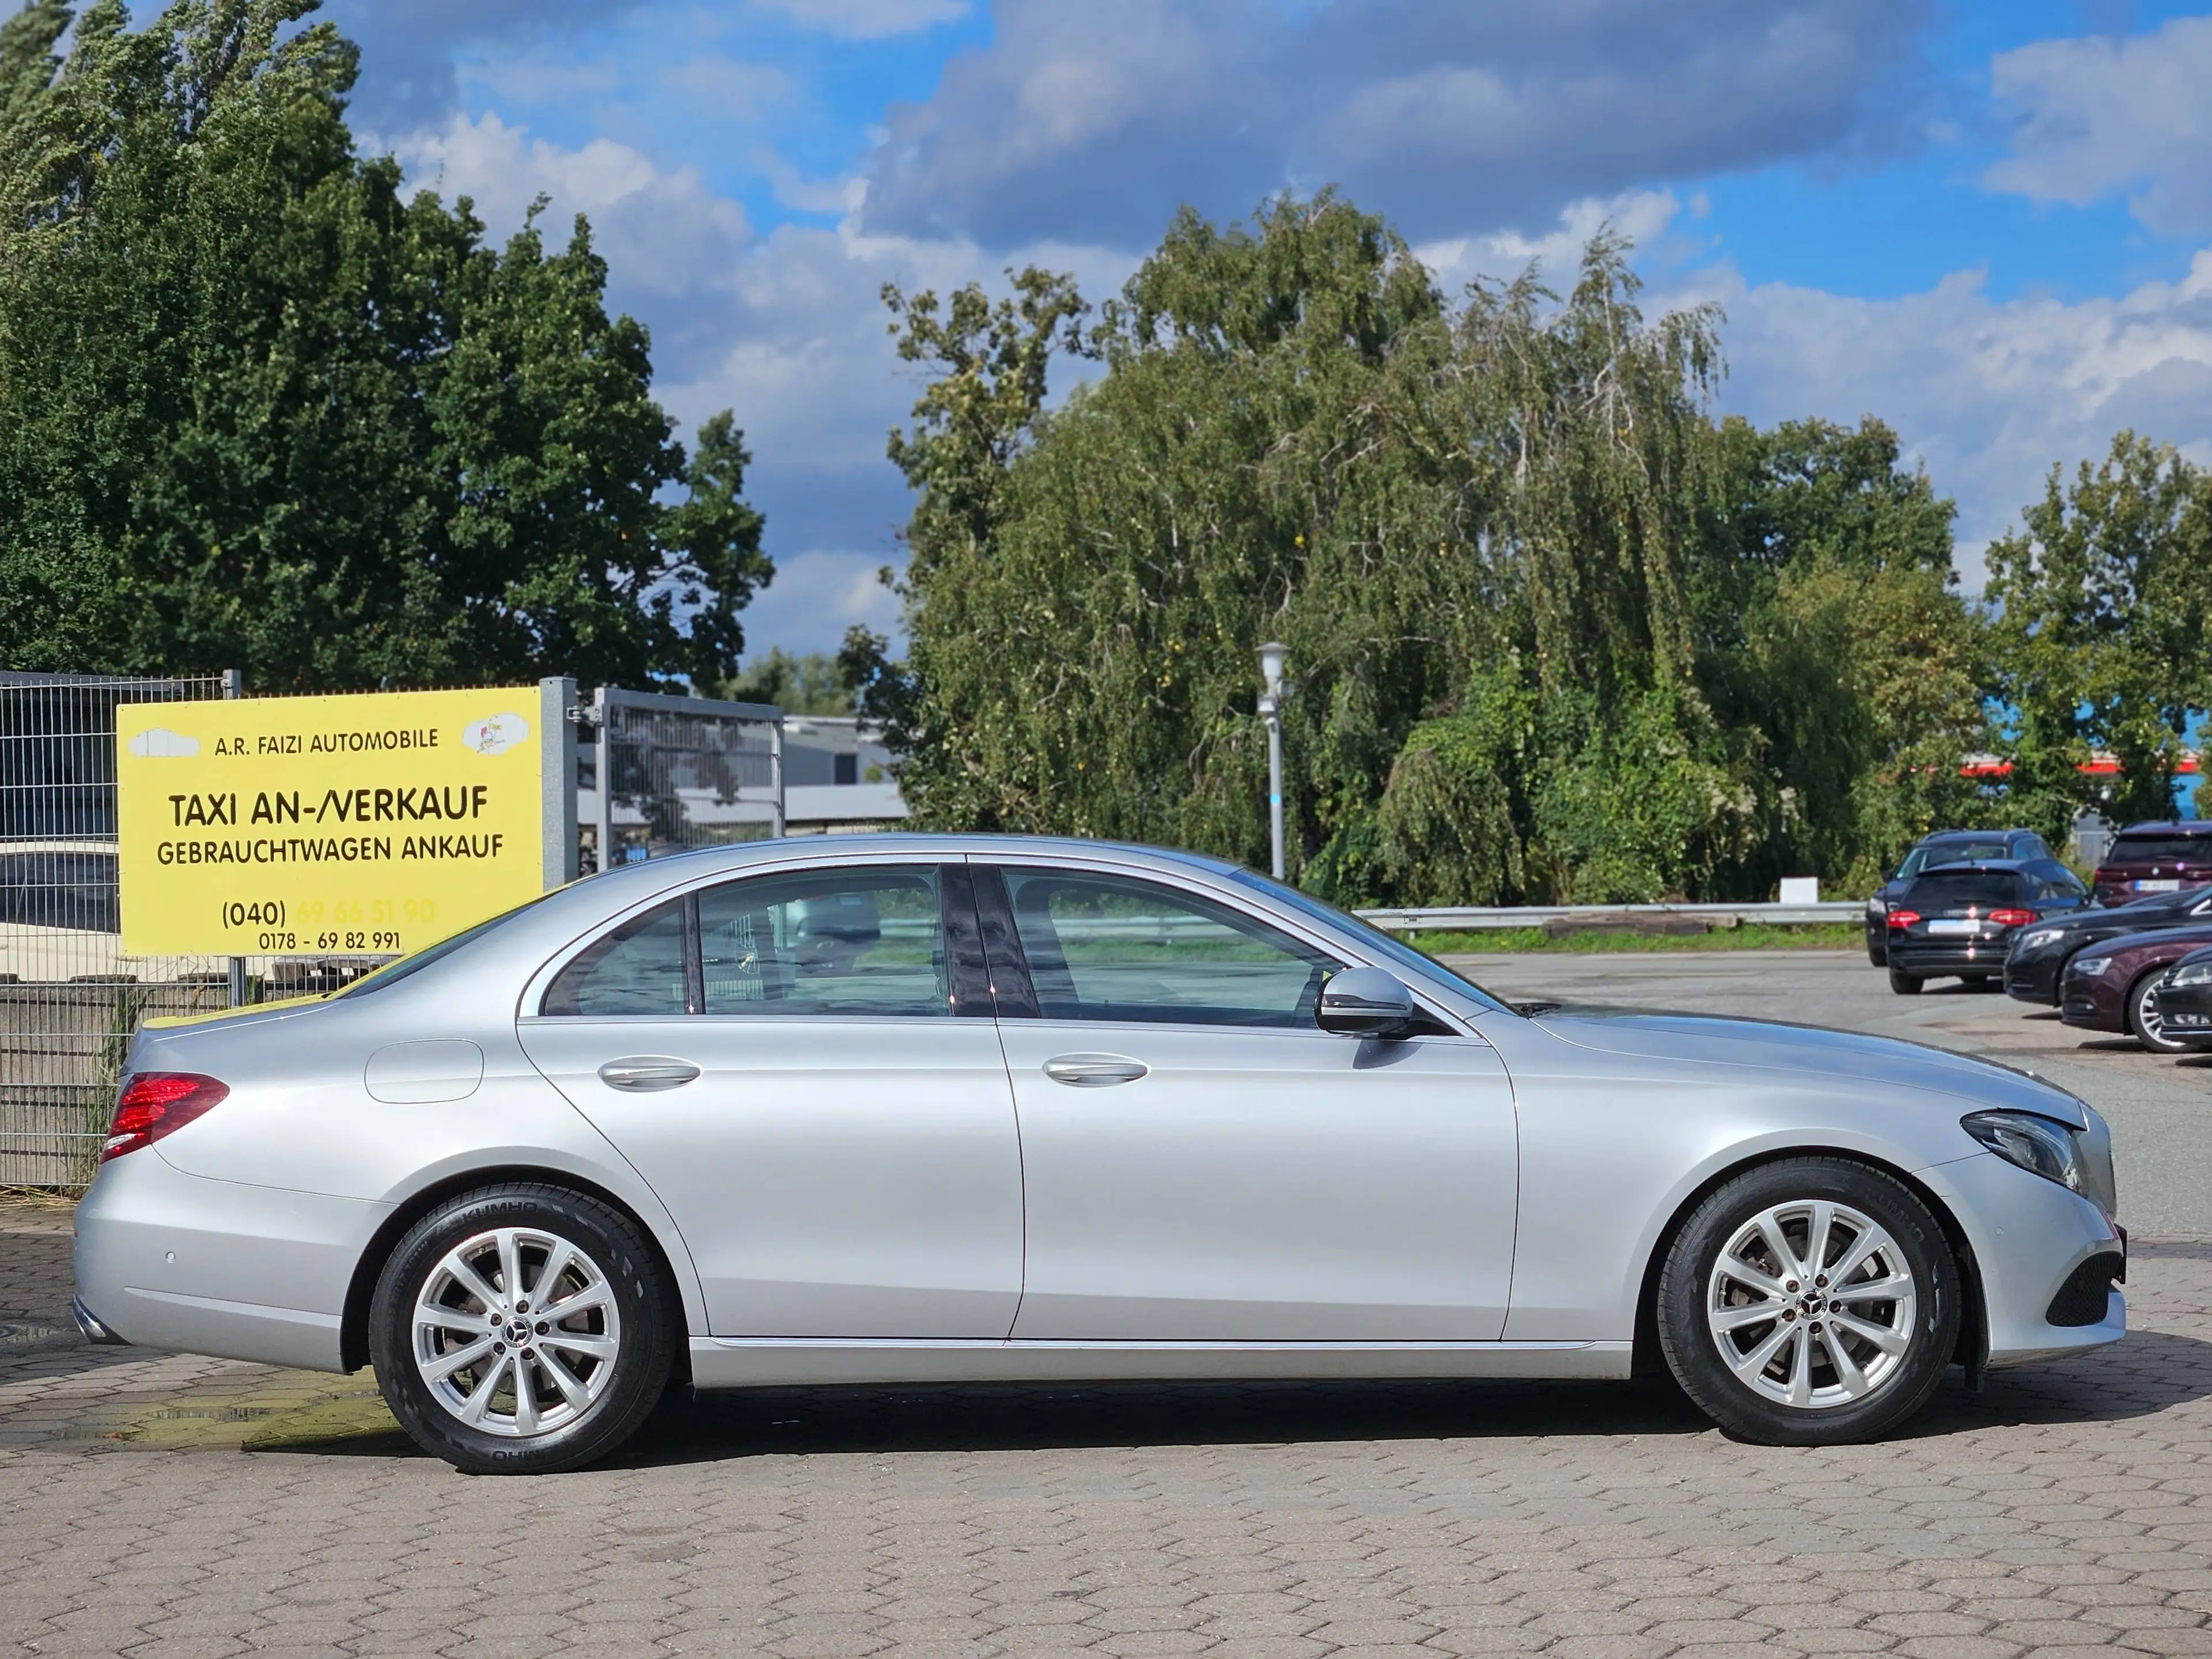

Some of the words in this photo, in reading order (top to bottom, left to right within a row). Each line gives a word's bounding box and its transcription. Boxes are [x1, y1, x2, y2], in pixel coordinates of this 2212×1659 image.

[215, 737, 250, 756] A.R.
[258, 735, 302, 755] FAIZI
[310, 728, 438, 753] AUTOMOBILE
[168, 793, 236, 827] TAXI
[157, 836, 391, 865] GEBRAUCHTWAGEN
[402, 834, 503, 859] ANKAUF
[222, 900, 286, 929] (040)
[296, 900, 324, 924] 69
[333, 900, 363, 923] 66
[404, 899, 436, 923] 90
[259, 932, 297, 949] 0178
[318, 932, 338, 949] 69
[346, 931, 366, 949] 82
[372, 931, 400, 949] 991
[462, 1202, 538, 1222] KUMHO
